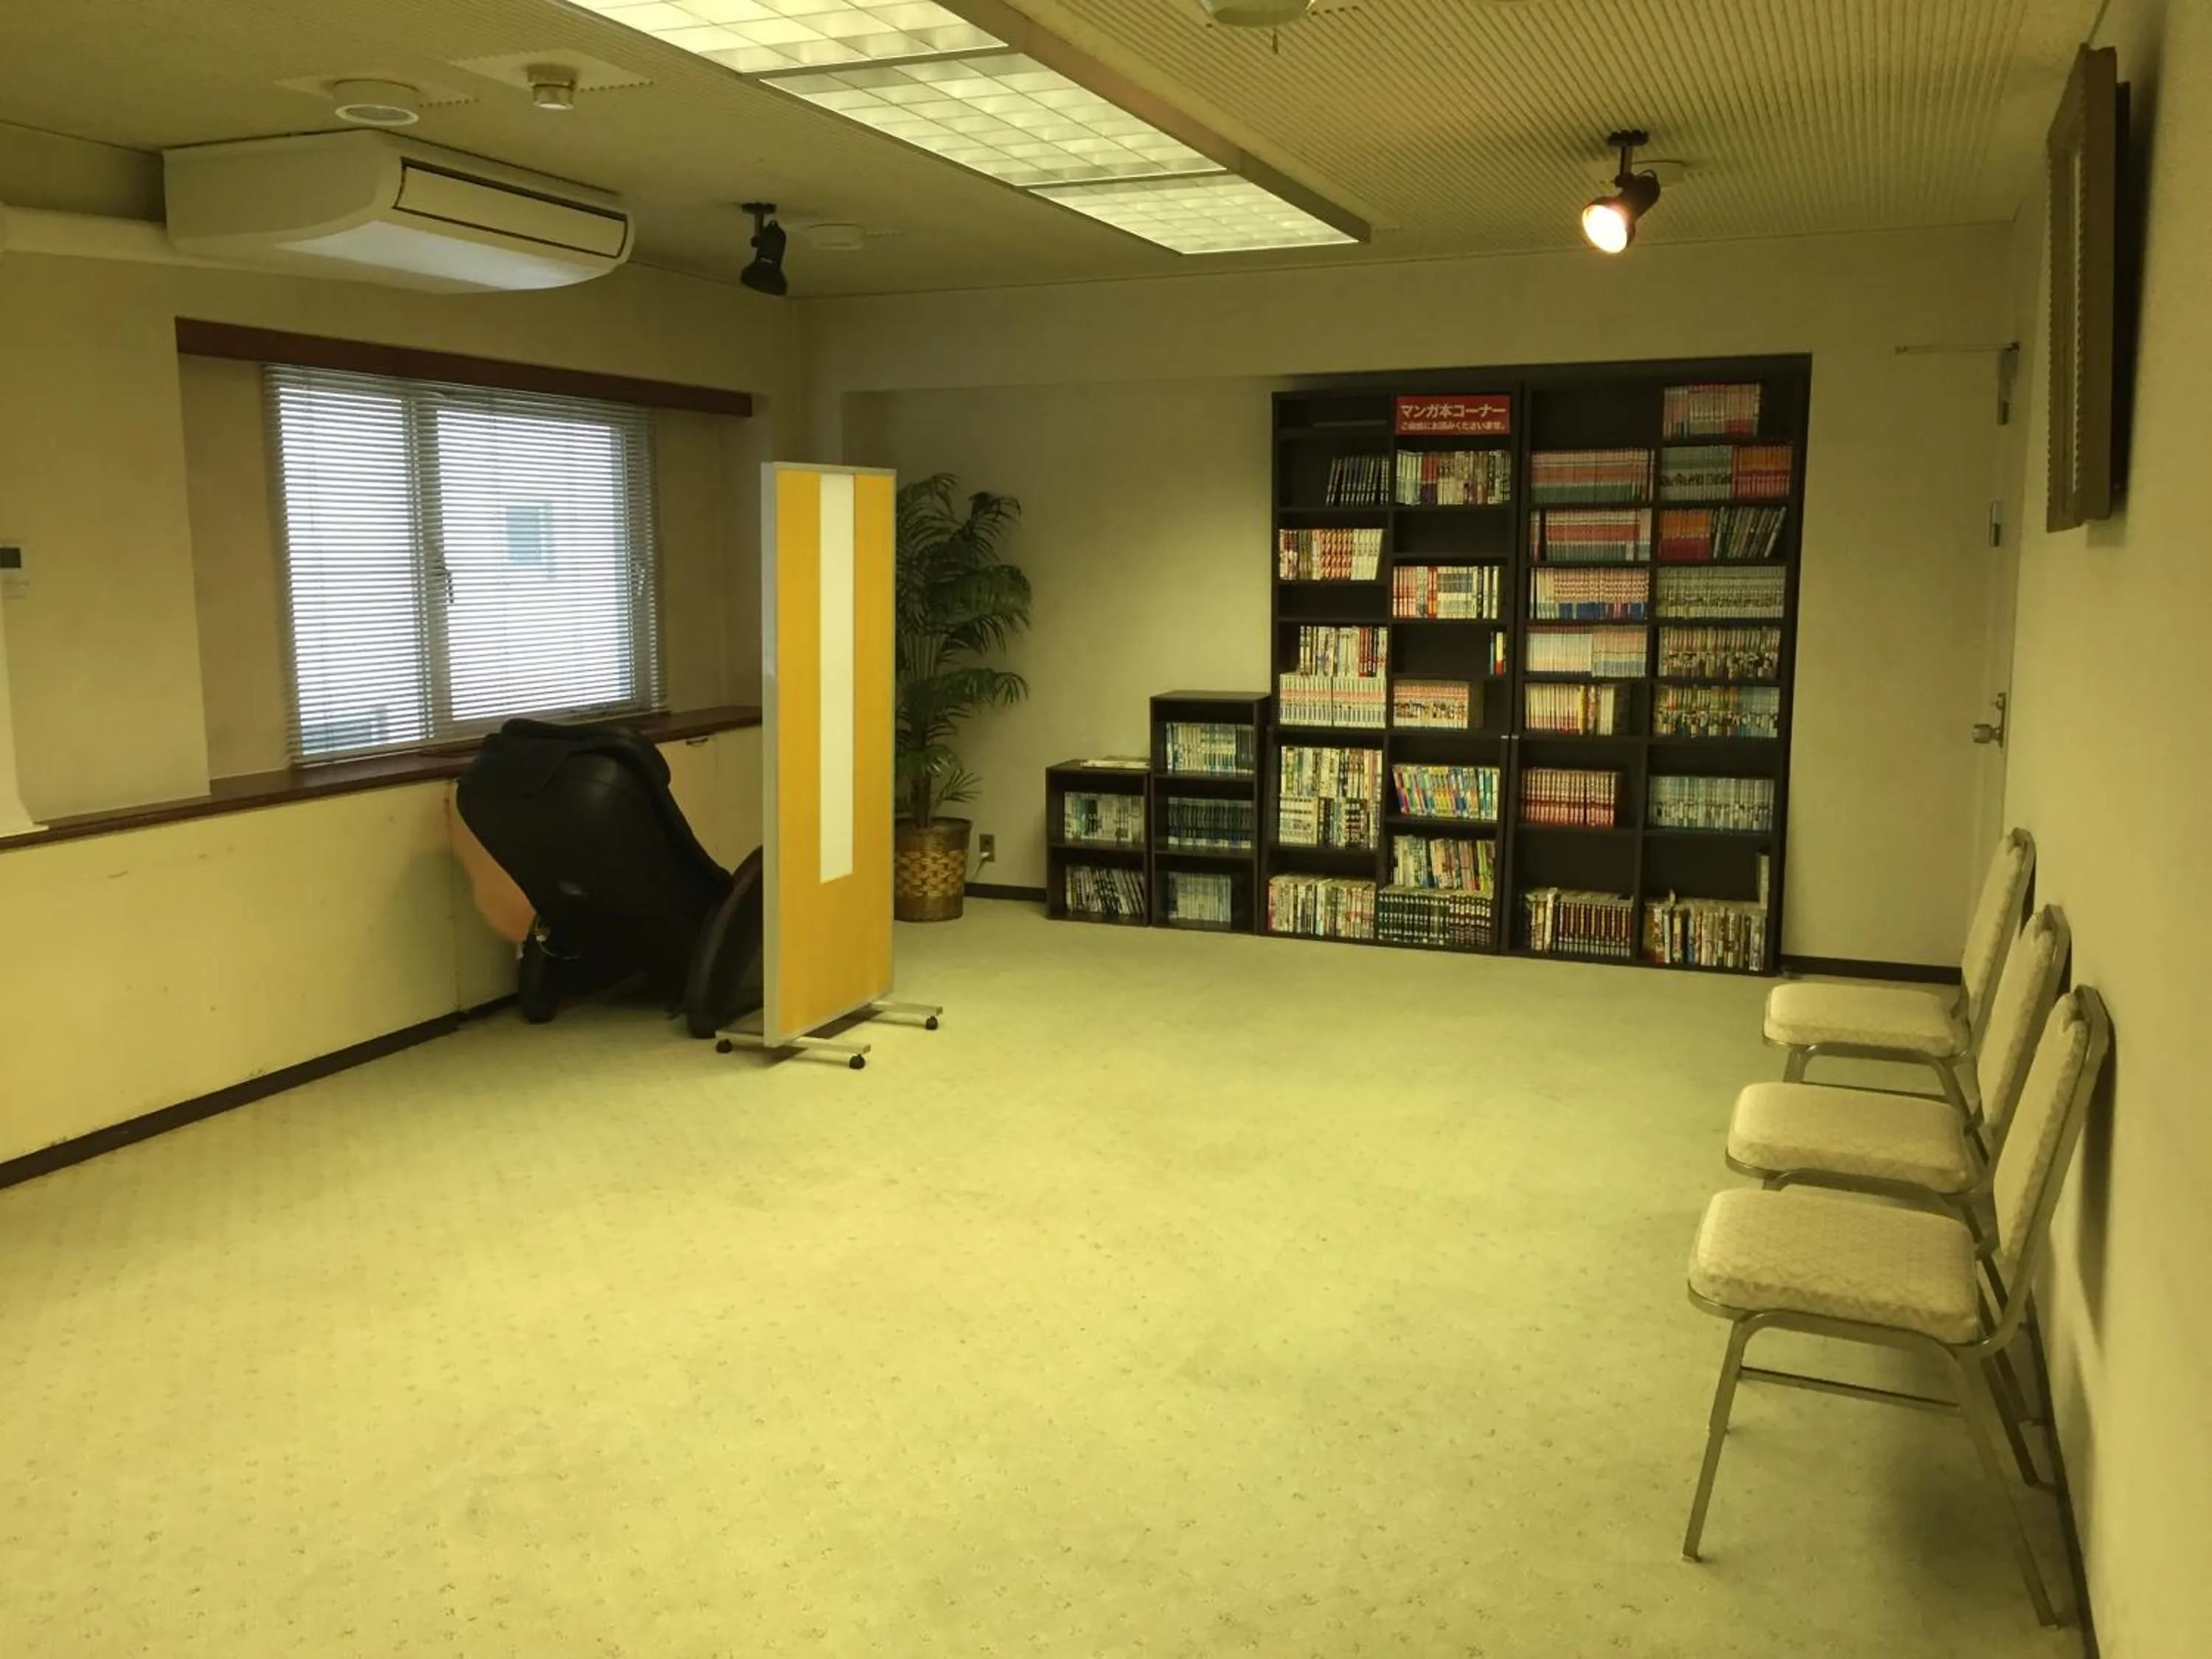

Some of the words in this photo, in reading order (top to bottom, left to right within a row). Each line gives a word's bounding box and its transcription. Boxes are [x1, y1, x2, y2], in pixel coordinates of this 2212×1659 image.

[1400, 403, 1506, 419] マンガ本コーナー
